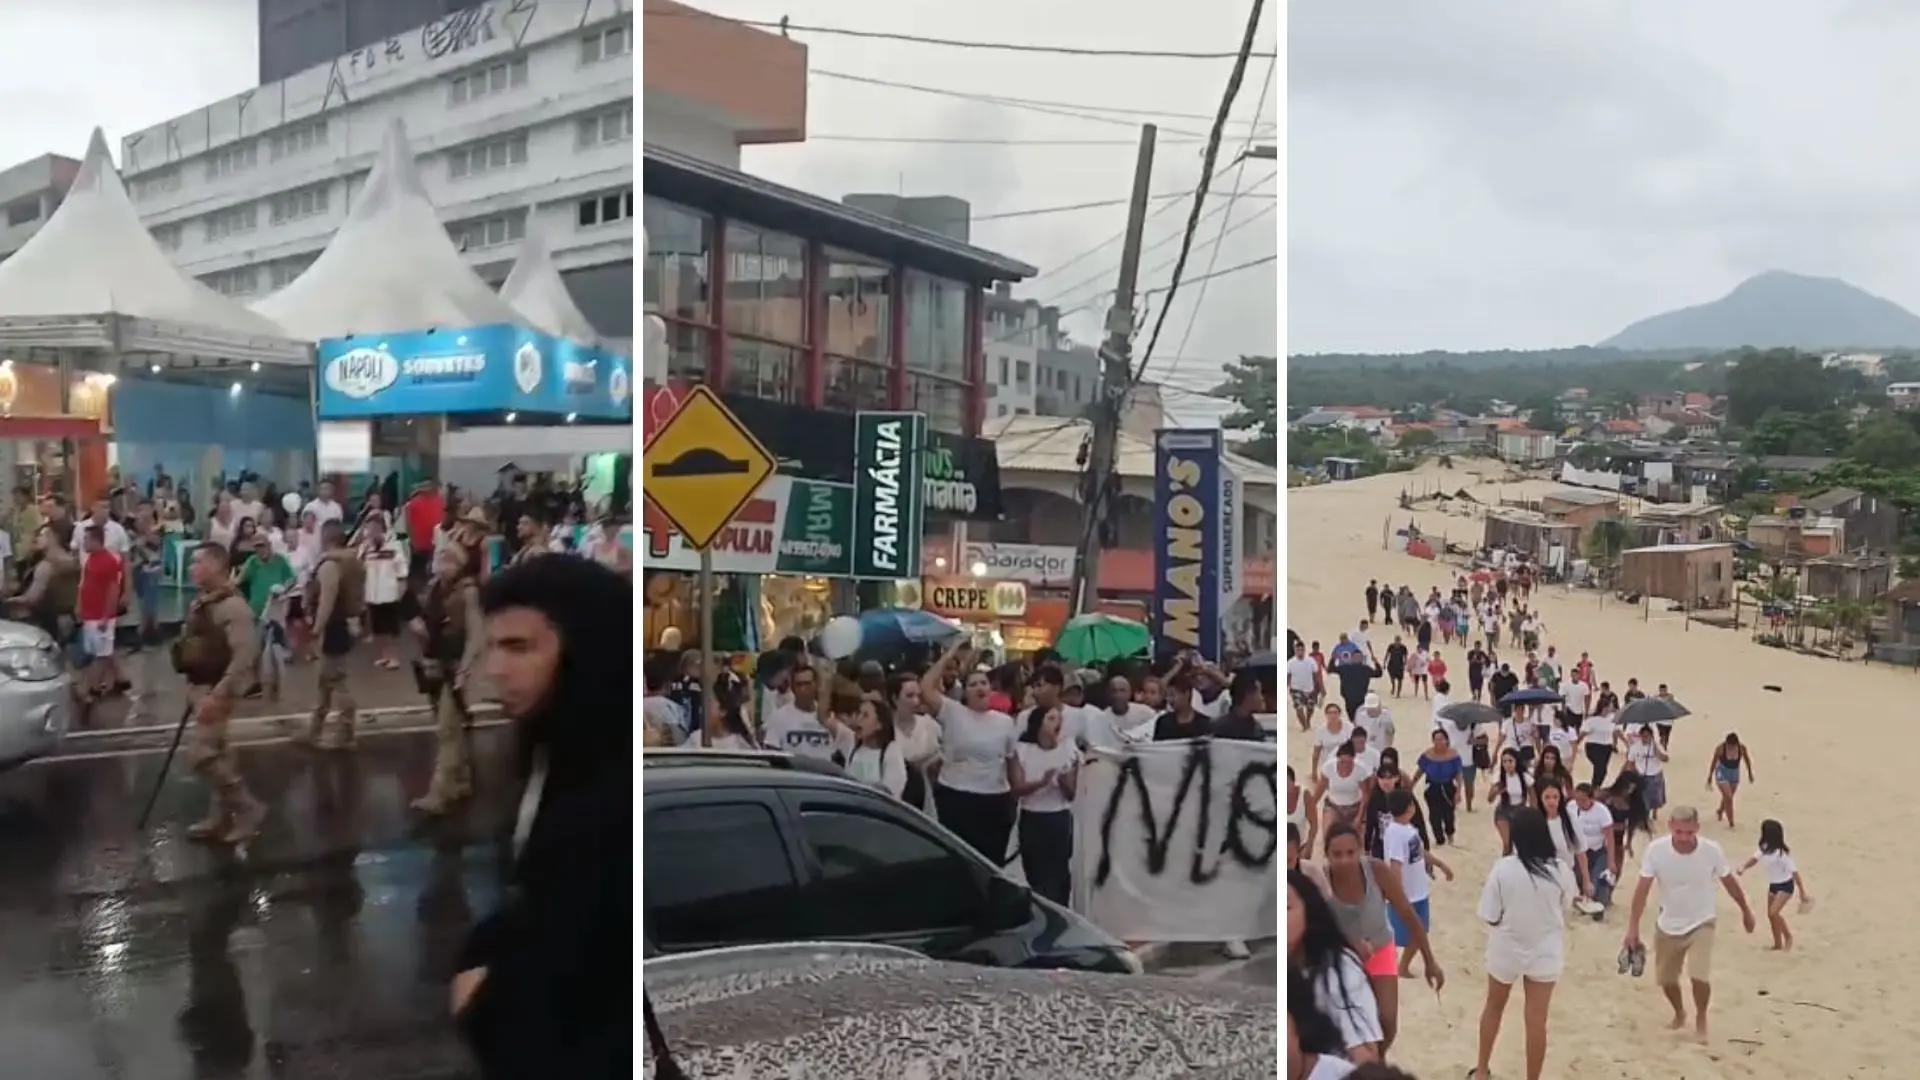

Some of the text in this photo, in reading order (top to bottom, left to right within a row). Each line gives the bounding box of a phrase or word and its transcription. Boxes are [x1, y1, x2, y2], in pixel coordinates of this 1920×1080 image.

[338, 353, 384, 382] NAPOLI
[868, 420, 902, 571] FARMÁCIA
[713, 525, 774, 555] OPULAR
[1162, 455, 1204, 647] MANO'S
[1222, 480, 1234, 594] SUPERMERCADO
[933, 587, 989, 610] CREPE
